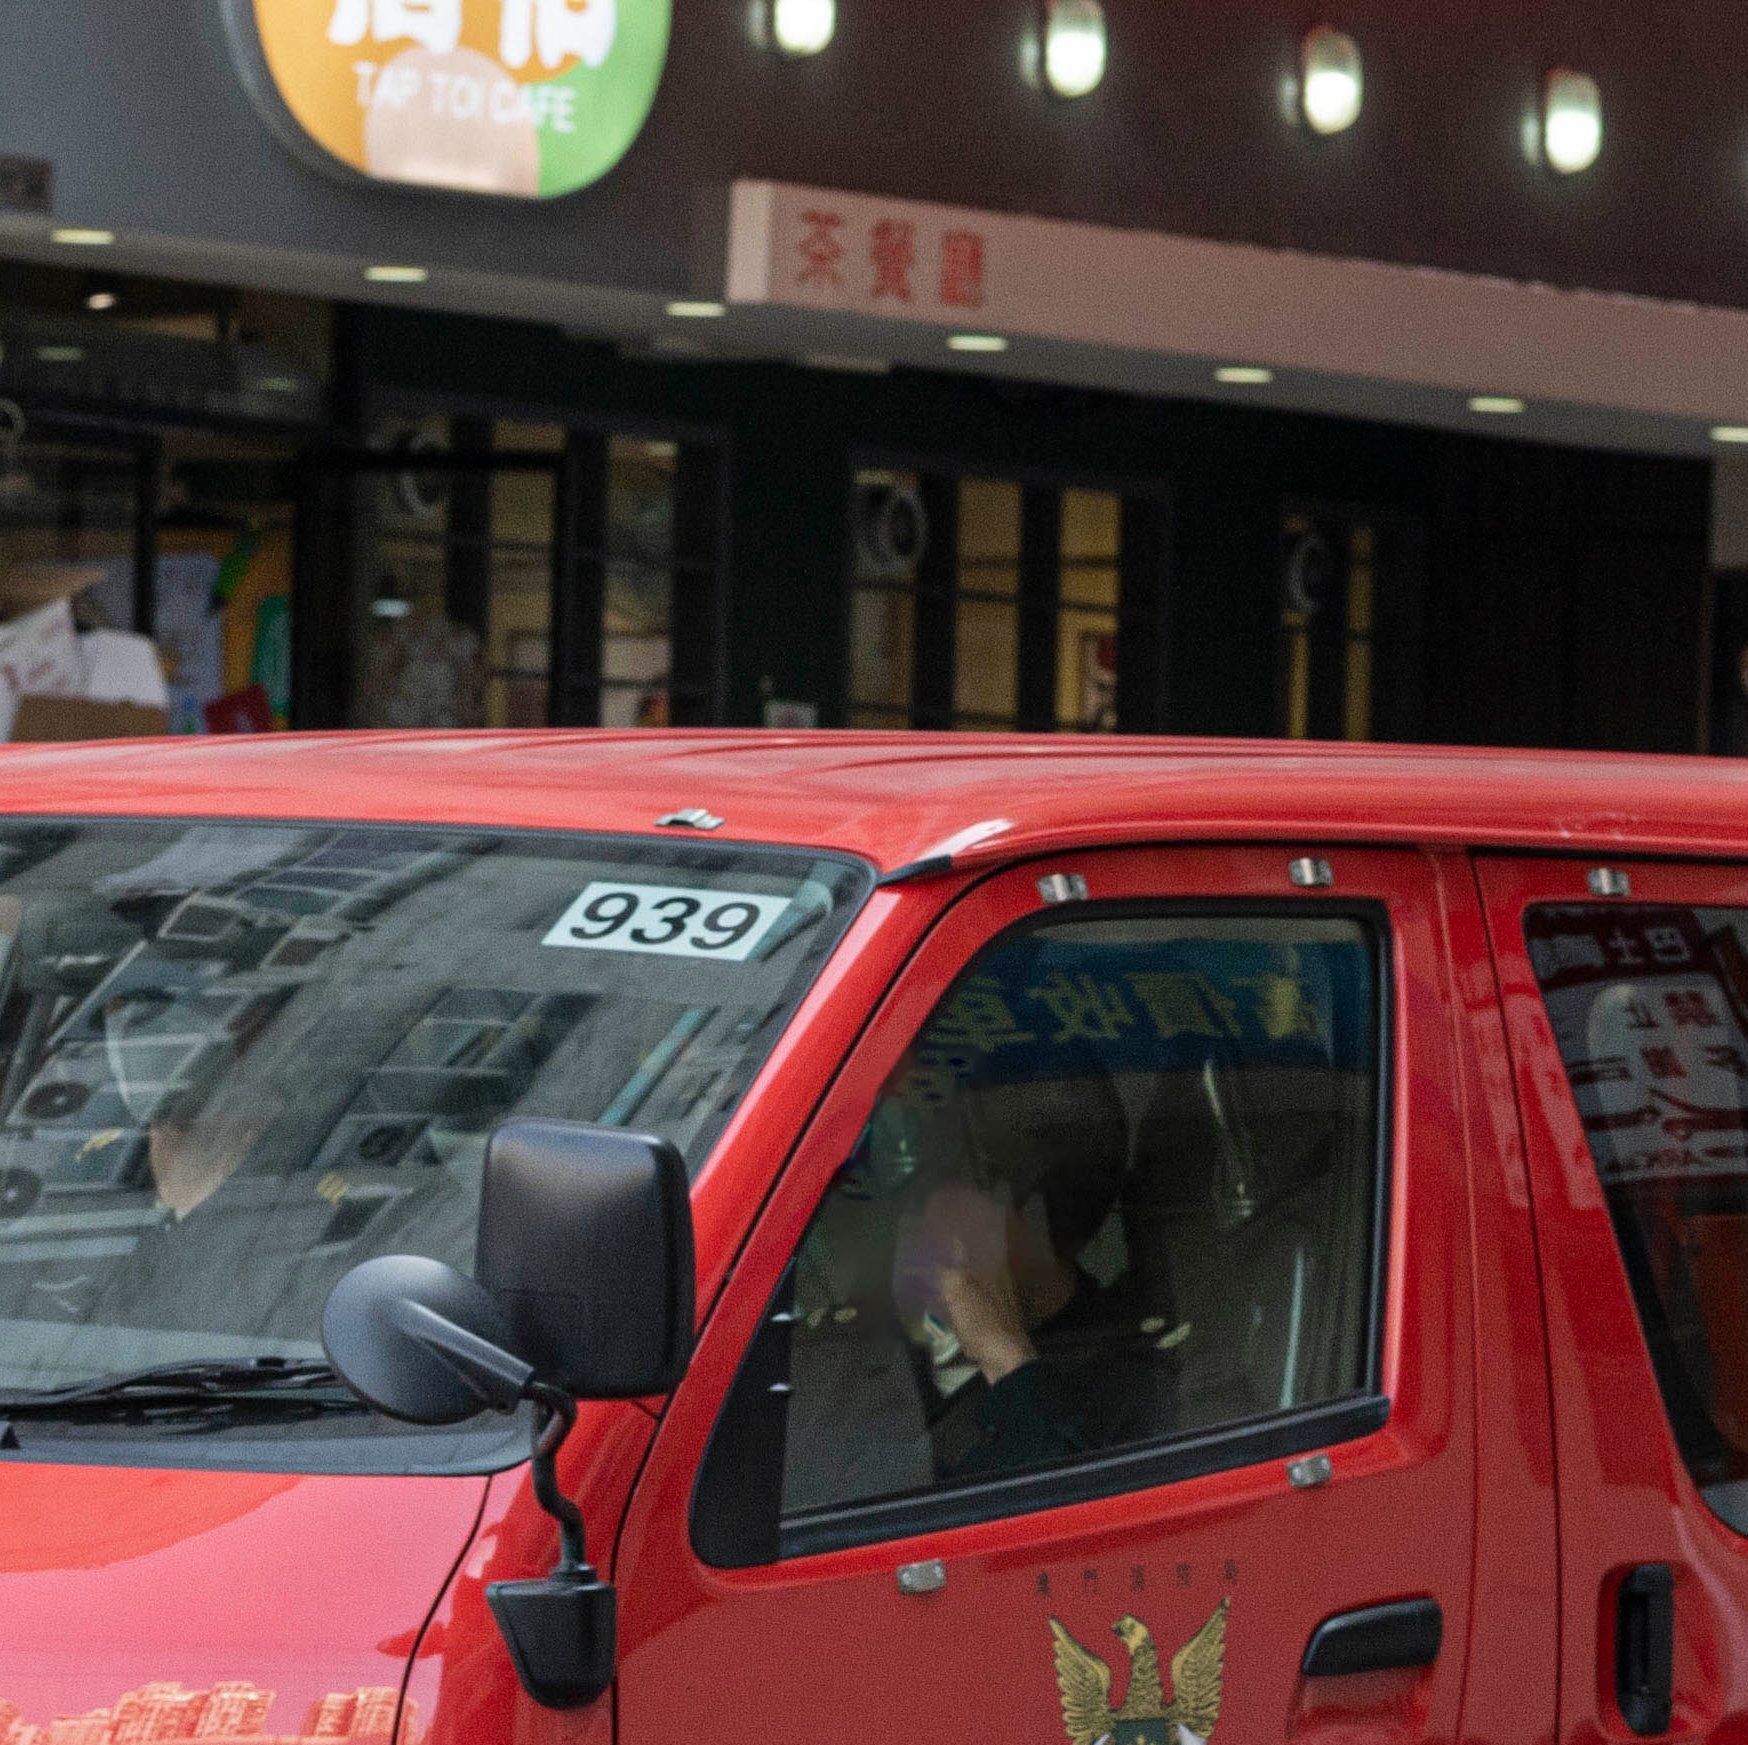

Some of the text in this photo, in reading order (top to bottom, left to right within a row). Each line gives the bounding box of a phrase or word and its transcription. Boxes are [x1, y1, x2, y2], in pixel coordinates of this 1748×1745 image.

[353, 59, 422, 109] TAP
[489, 78, 578, 134] CAFE
[568, 891, 763, 953] 939
